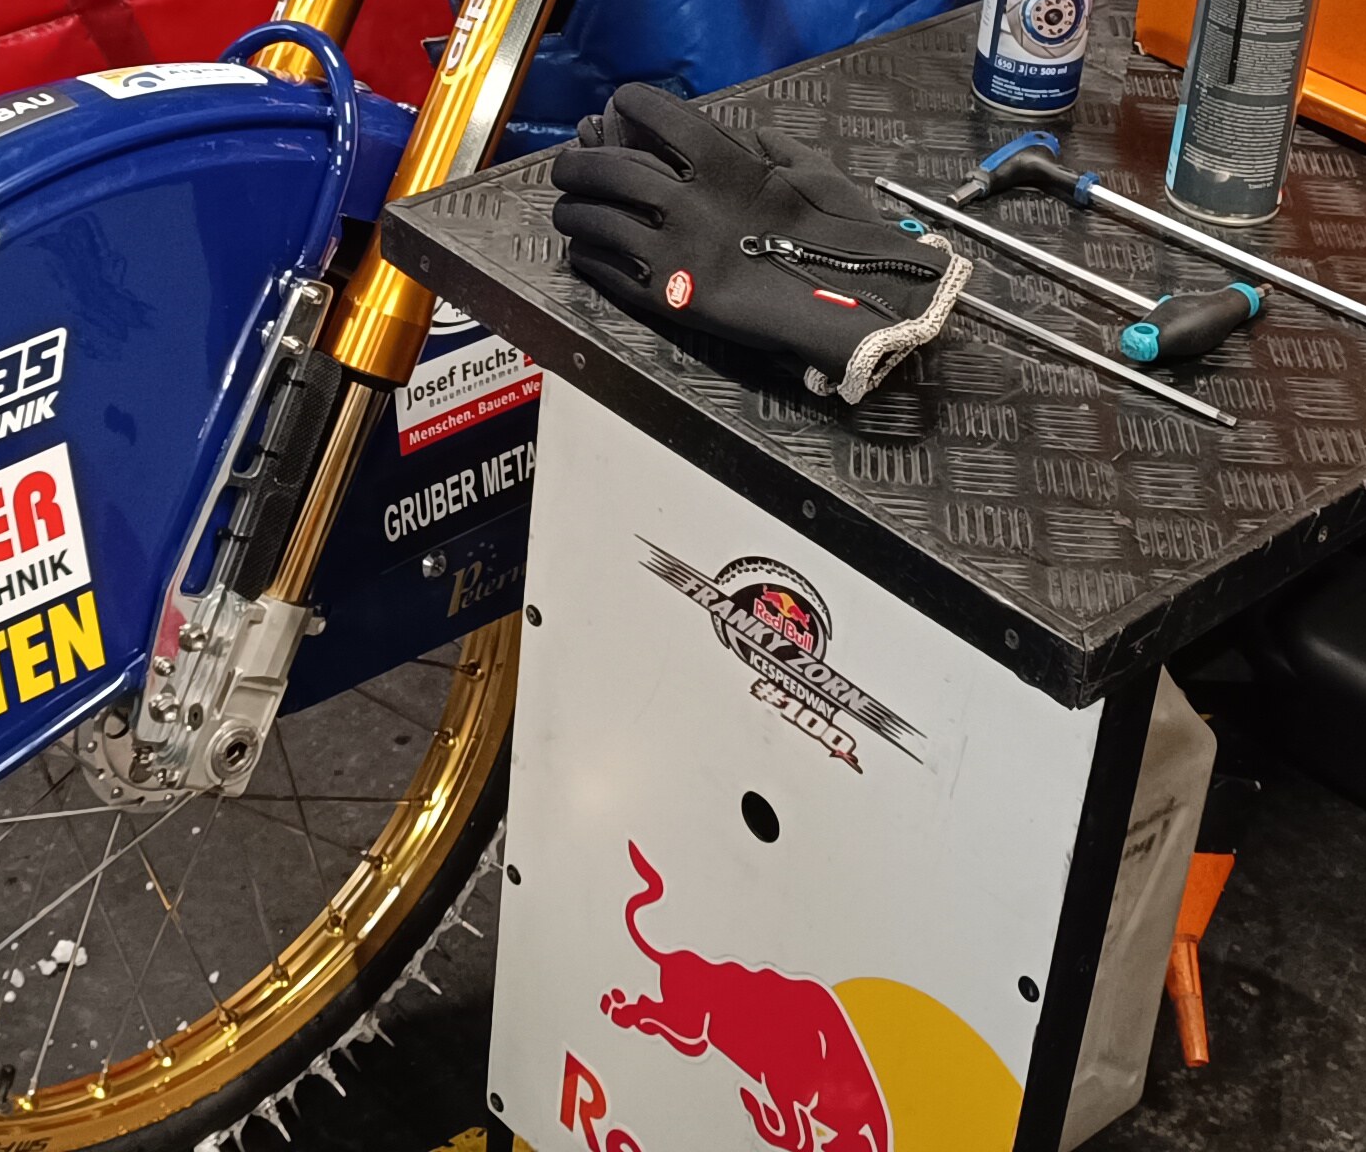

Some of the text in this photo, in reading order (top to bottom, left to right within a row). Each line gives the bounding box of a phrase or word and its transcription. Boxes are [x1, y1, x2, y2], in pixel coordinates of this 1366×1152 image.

[405, 346, 519, 411] Josef Fuchs
[428, 364, 520, 409] Bauunternehmen
[408, 379, 542, 447] Menschen. Bauen. We
[384, 467, 479, 543] GRUBER
[680, 580, 870, 713] FRANKY ZORN
[752, 597, 814, 654] Red Bull
[748, 650, 836, 721] ICESPEEDWAY
